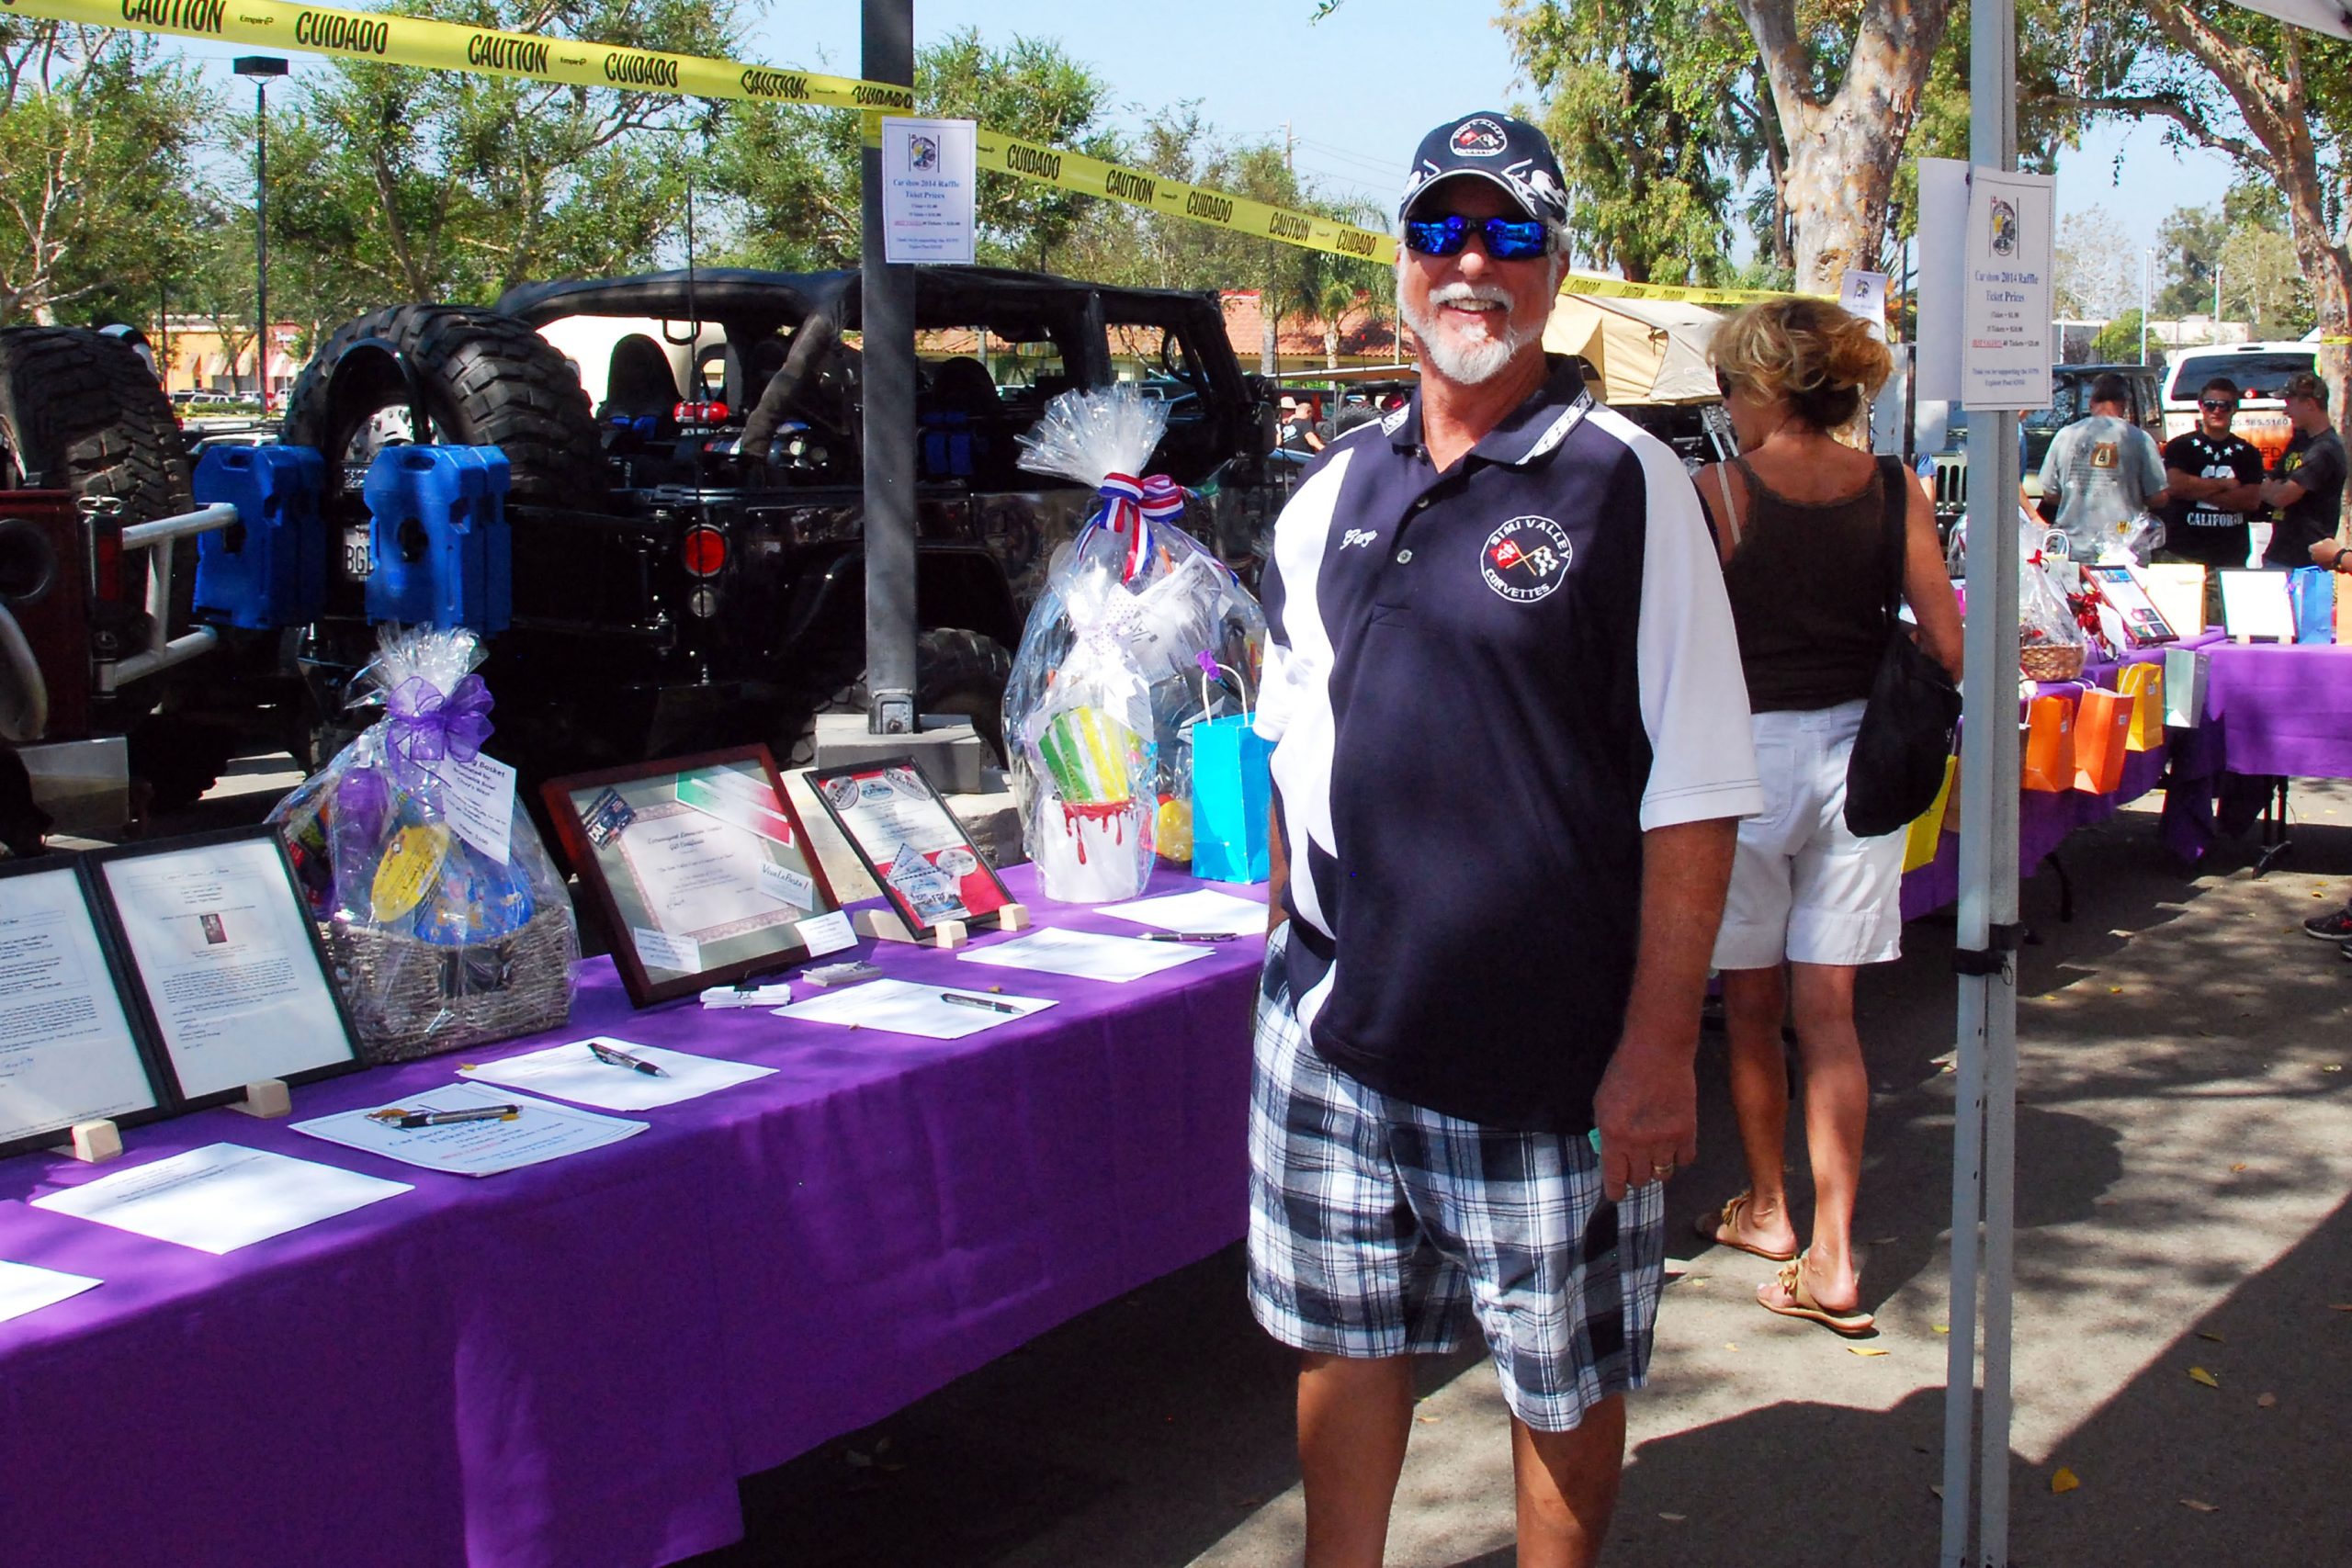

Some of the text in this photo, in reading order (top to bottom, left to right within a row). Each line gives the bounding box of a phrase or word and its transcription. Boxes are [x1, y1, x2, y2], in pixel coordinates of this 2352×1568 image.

[122, 0, 226, 33] CAUTION
[295, 10, 389, 55] CUIDADO
[468, 34, 548, 73] CAUTION
[604, 51, 678, 88] CUIDADO
[741, 69, 809, 99] CAUTION
[1007, 143, 1376, 256] CUIDADO CAUTION CUIDADO CAUTION CUIDADO
[1490, 518, 1571, 560] SIMI VALLEY
[1485, 568, 1551, 599] CORVETTES
